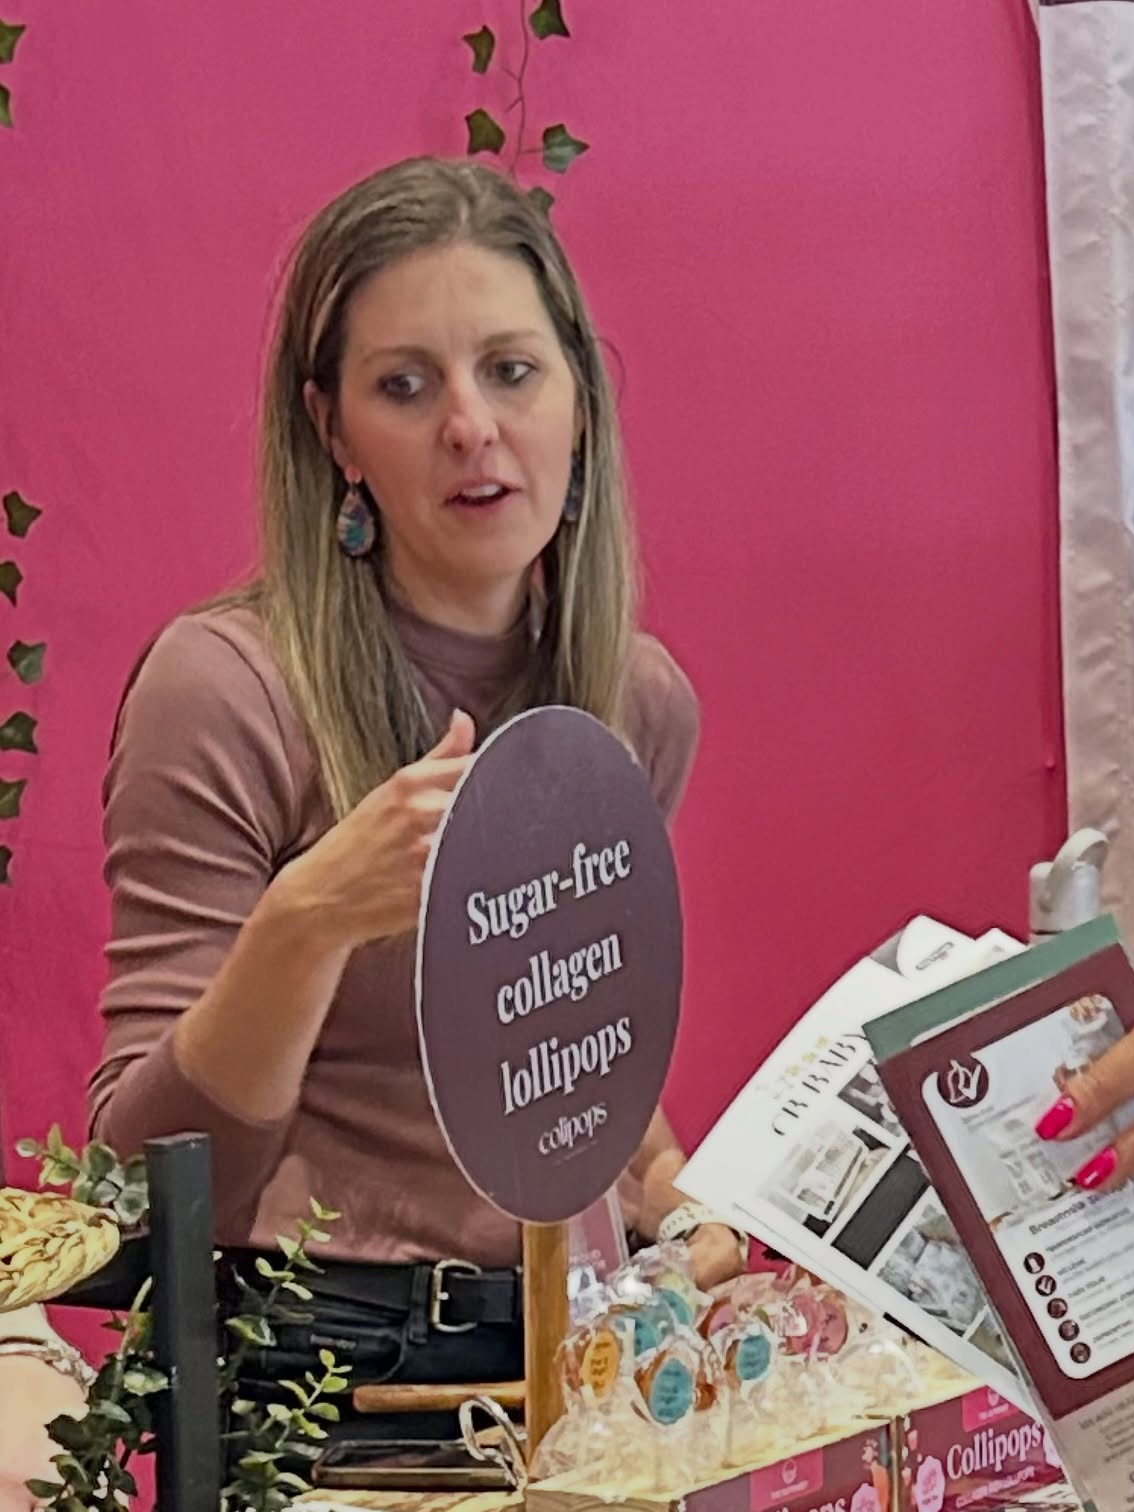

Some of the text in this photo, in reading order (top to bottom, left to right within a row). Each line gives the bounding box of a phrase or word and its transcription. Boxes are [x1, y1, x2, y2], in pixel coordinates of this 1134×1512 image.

[467, 838, 632, 945] Sugar-free
[497, 932, 622, 1025] collagen
[501, 1015, 632, 1116] lollipops
[947, 1423, 1042, 1480] Collipops
